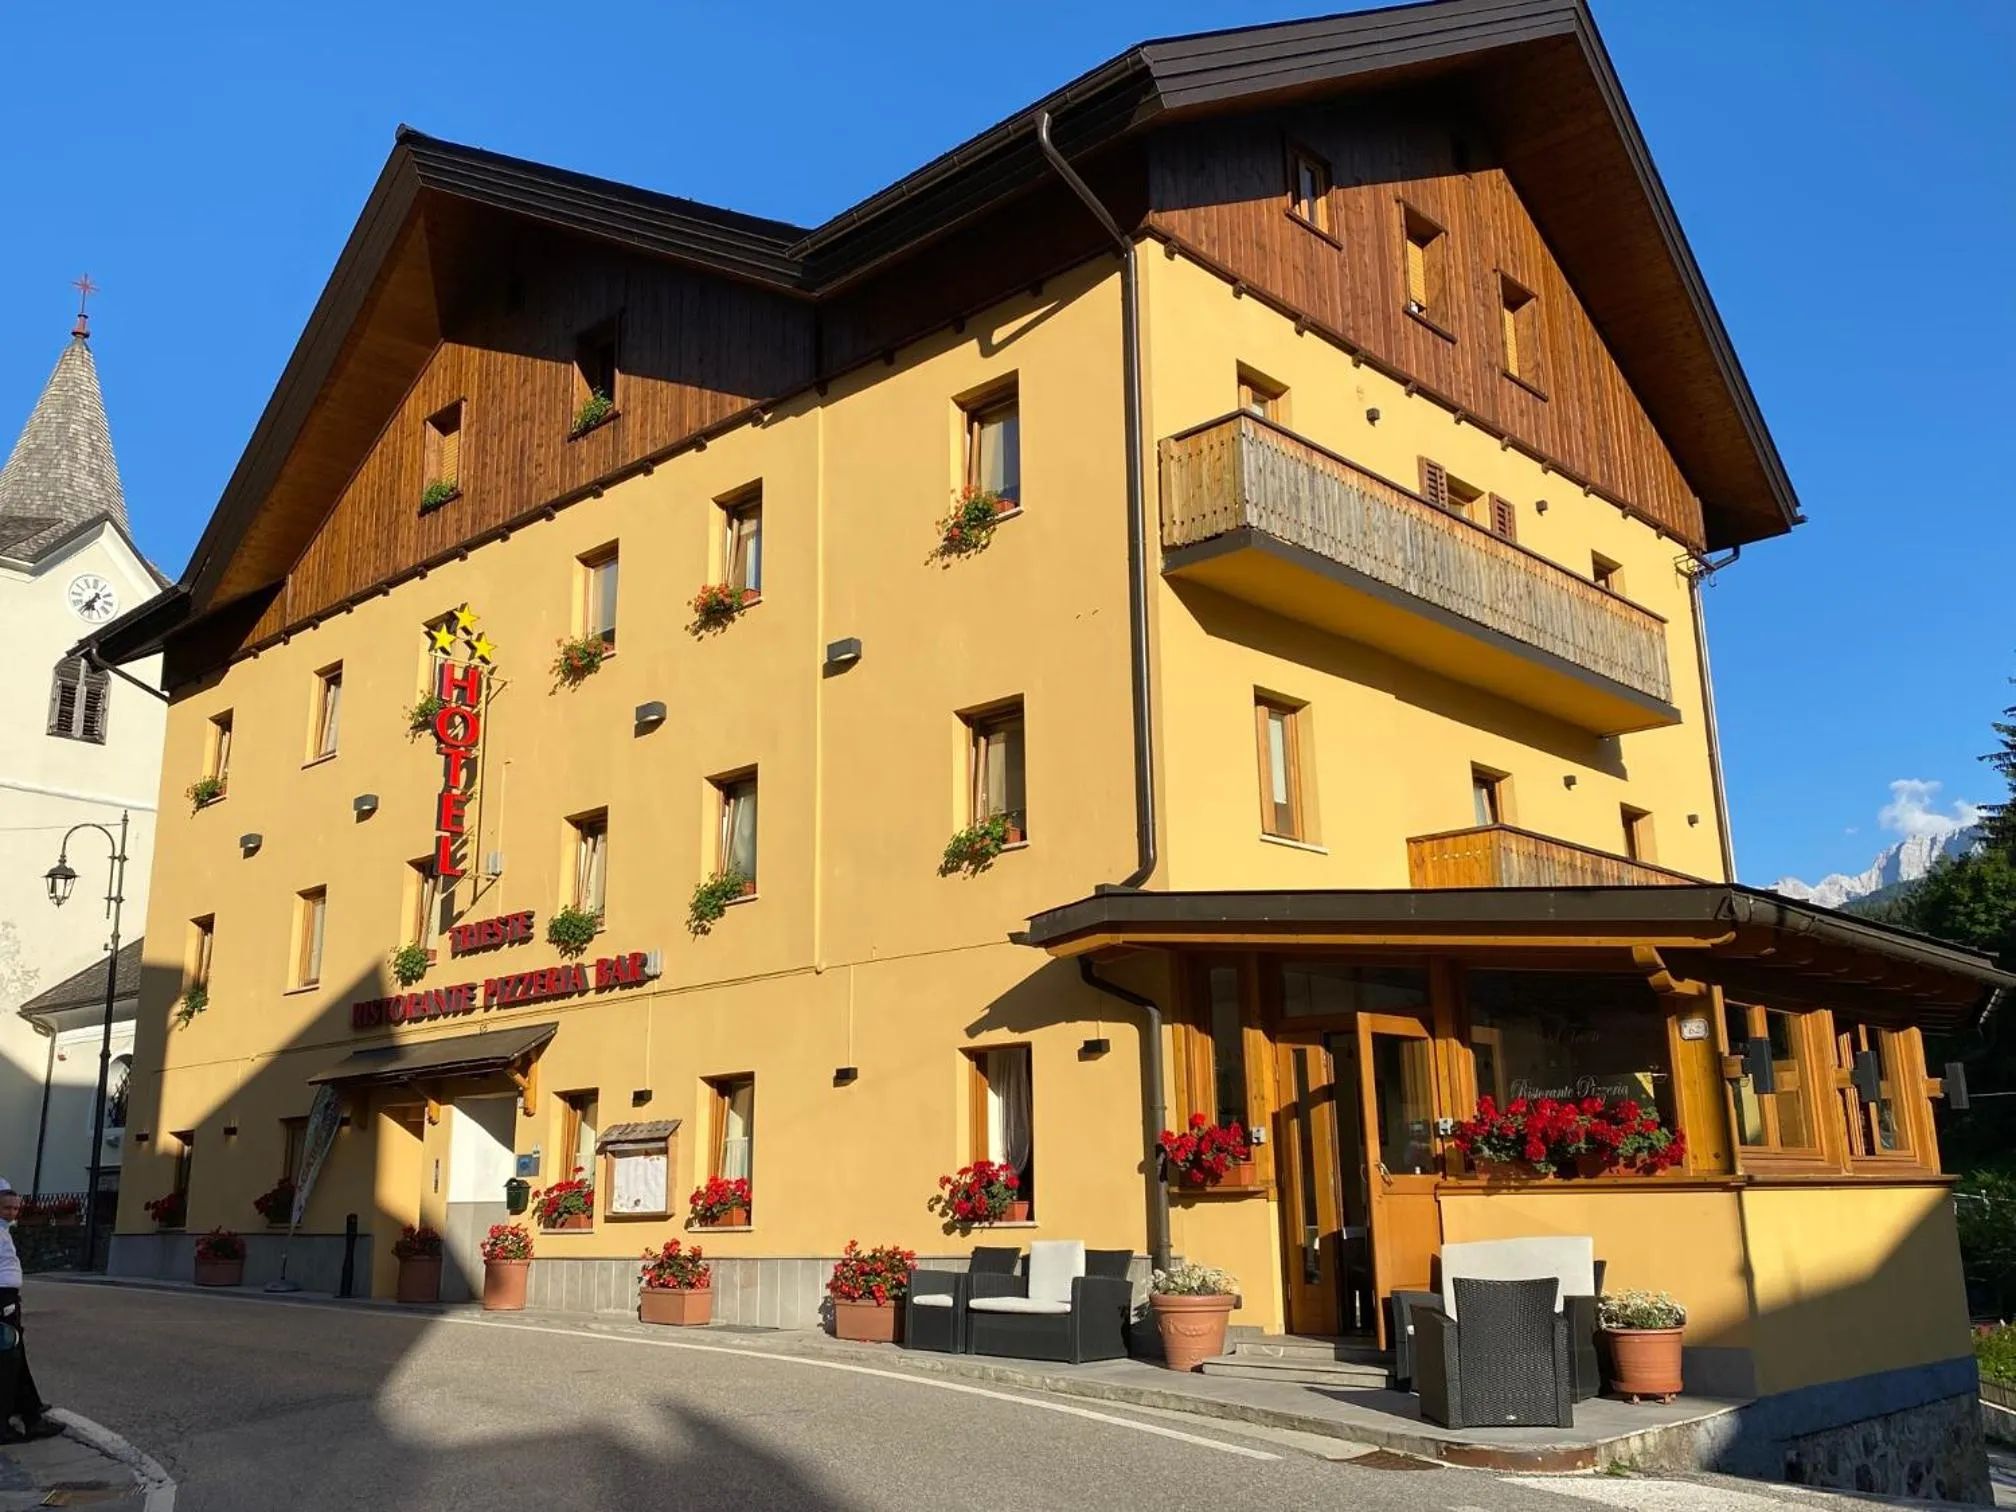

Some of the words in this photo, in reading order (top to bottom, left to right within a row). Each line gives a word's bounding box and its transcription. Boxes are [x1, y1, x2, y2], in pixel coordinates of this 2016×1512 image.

[435, 662, 481, 876] HOTEL
[449, 910, 535, 957] TRIESTE
[352, 982, 477, 1029] RISTORANTE
[484, 962, 589, 1010] PIZZERIA
[596, 951, 648, 993] BAR
[1577, 1074, 1629, 1104] Pizzeria
